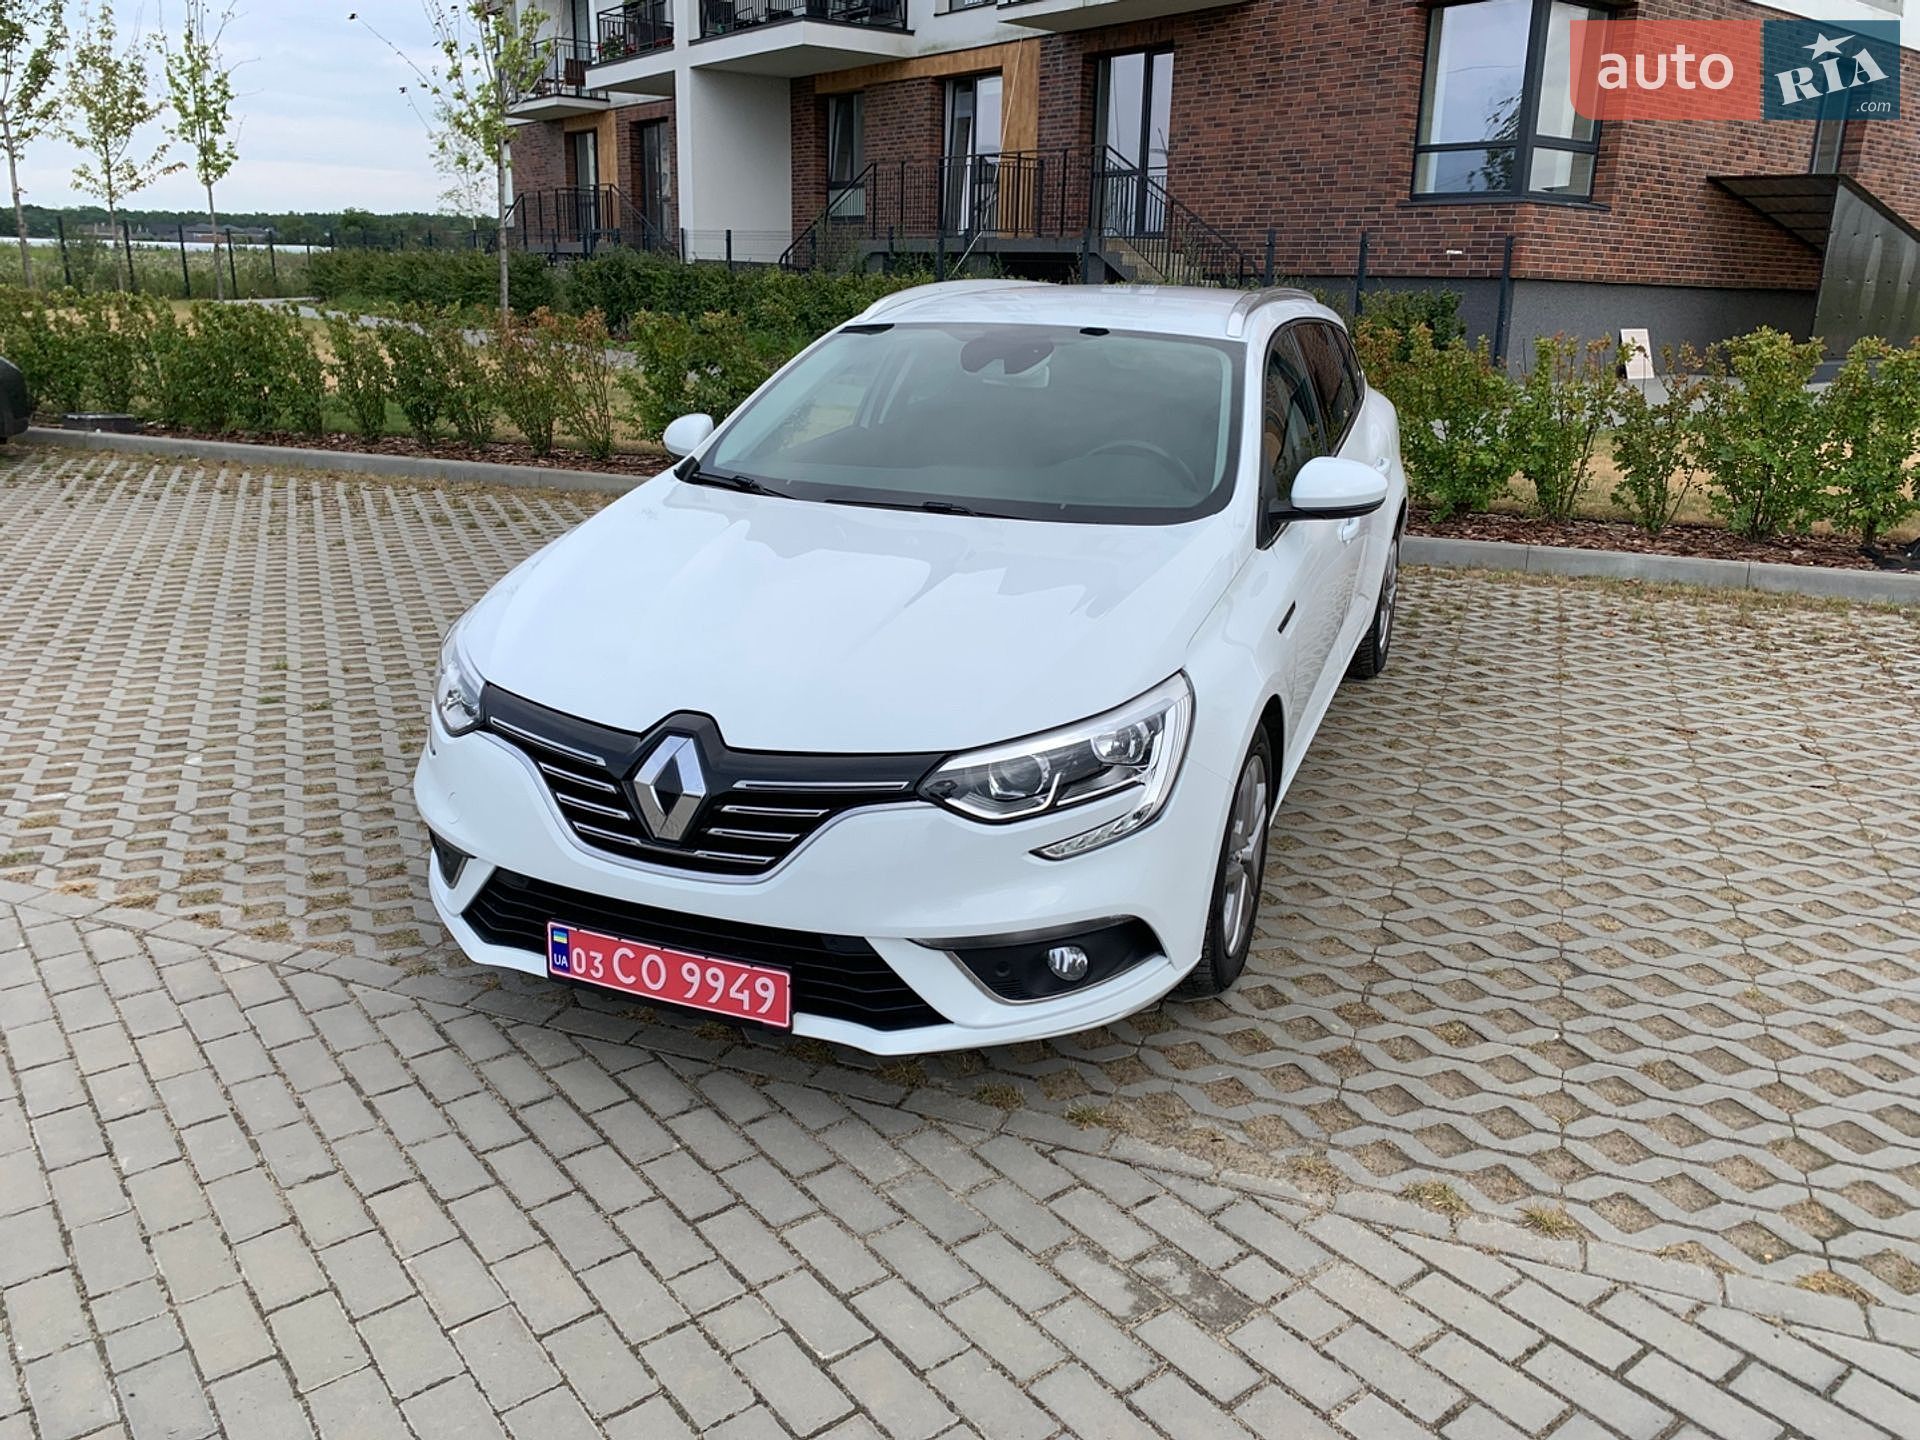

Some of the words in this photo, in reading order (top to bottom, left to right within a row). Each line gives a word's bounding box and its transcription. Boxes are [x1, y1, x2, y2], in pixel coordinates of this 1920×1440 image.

[554, 954, 569, 968] UA
[571, 947, 604, 979] 03
[613, 947, 667, 991] CO
[681, 961, 776, 1014] 9949
